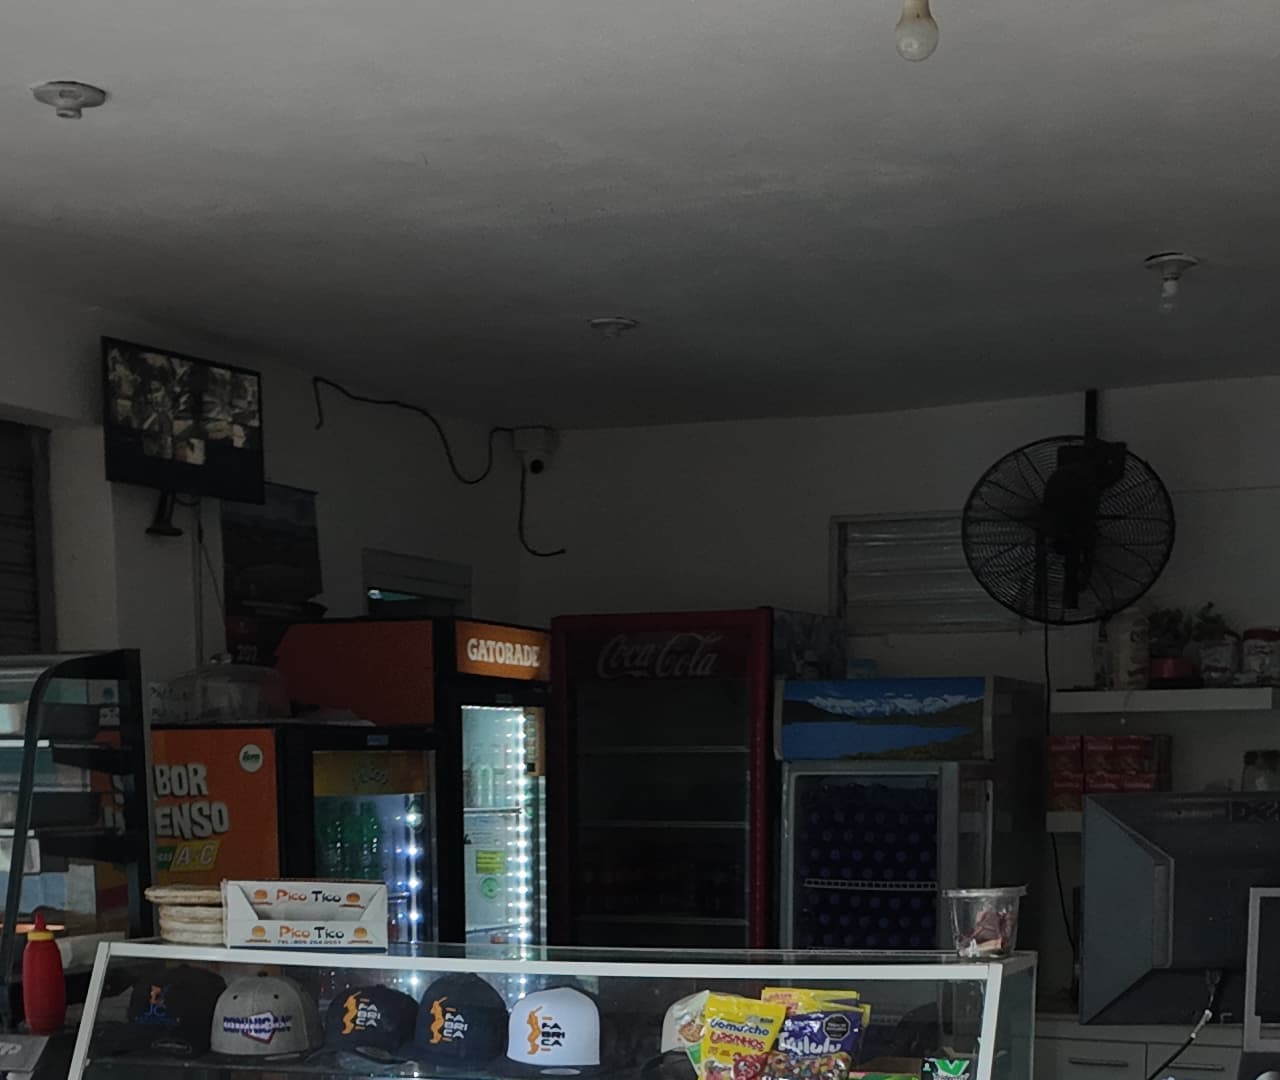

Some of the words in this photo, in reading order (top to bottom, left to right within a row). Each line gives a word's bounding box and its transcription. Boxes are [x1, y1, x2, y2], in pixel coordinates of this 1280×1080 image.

[466, 637, 541, 668] GATORADE
[597, 631, 724, 679] Coca-Cola
[153, 763, 208, 800] BOR
[276, 889, 308, 902] Pico
[312, 890, 342, 903] Tico
[279, 925, 311, 939] Pico
[314, 926, 345, 939] Tico
